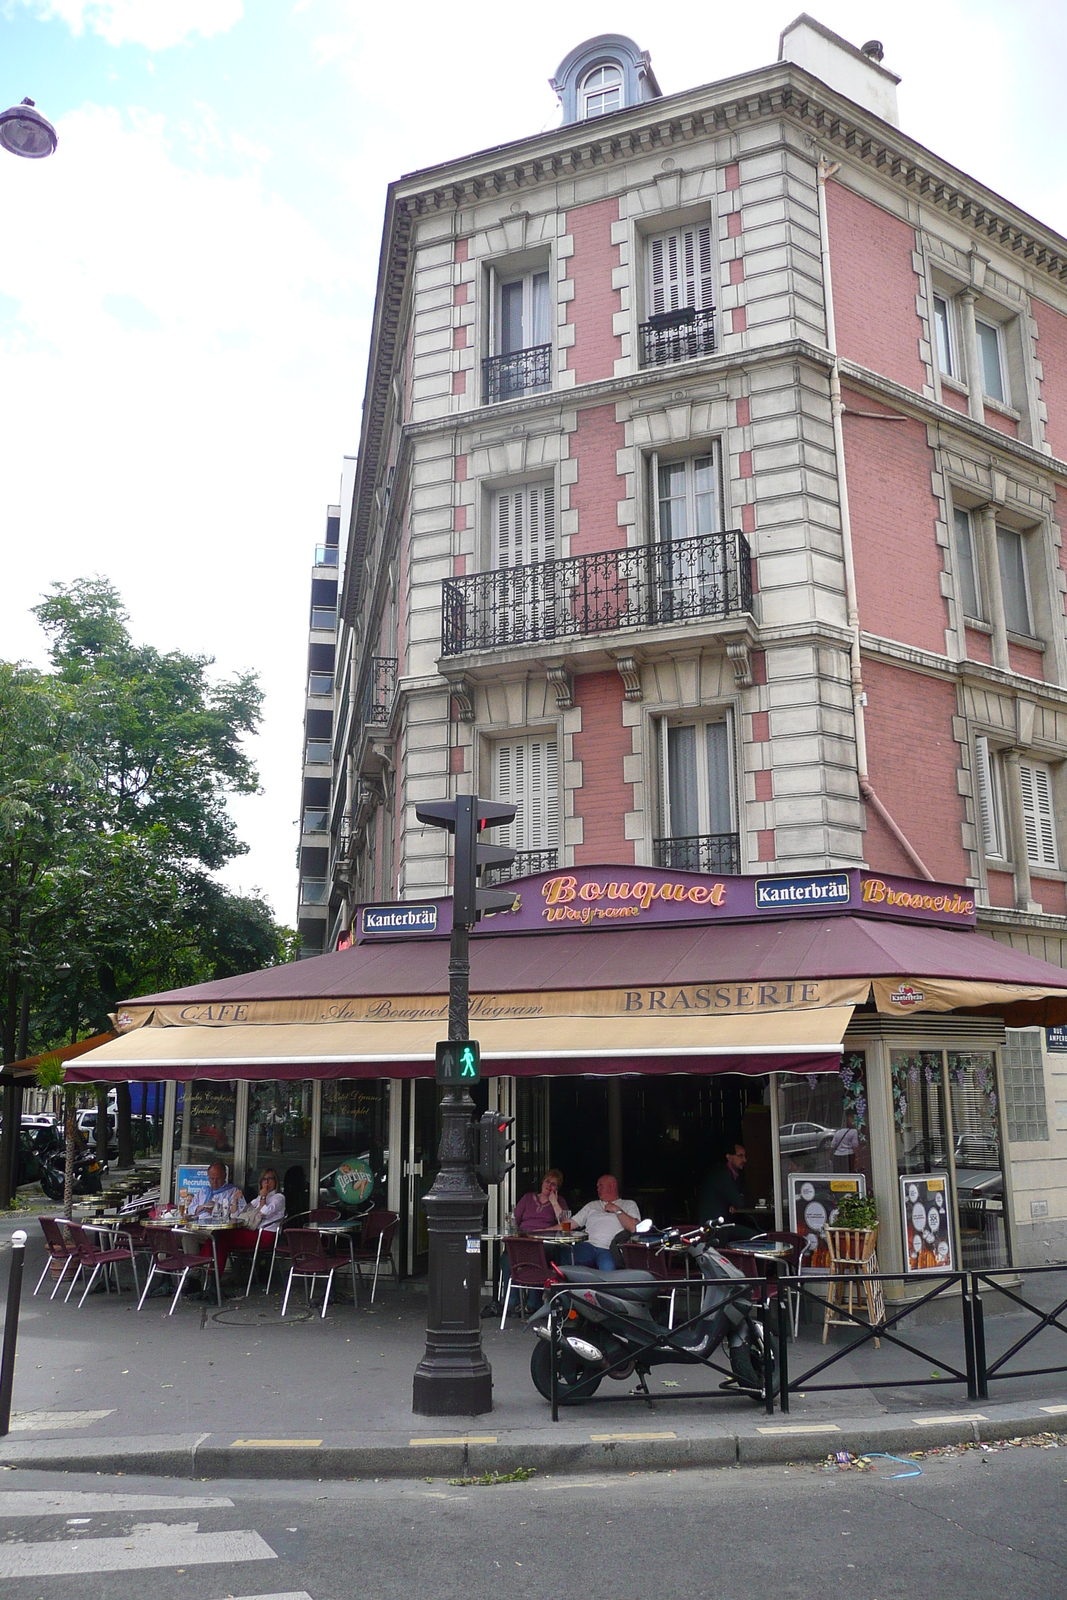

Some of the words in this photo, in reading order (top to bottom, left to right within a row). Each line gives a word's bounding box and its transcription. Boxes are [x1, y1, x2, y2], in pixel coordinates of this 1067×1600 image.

[542, 876, 726, 909] Bouquet
[759, 882, 848, 902] Kanterbräu
[860, 879, 975, 915] Brasserie
[366, 910, 437, 927] Kanterbräu
[542, 905, 641, 924] Wagram
[321, 1001, 355, 1020] Au
[365, 1000, 448, 1019] Bouquet
[468, 996, 544, 1018] Wagram
[623, 983, 820, 1011] BRASSERIE
[180, 1004, 249, 1021] CAFE
